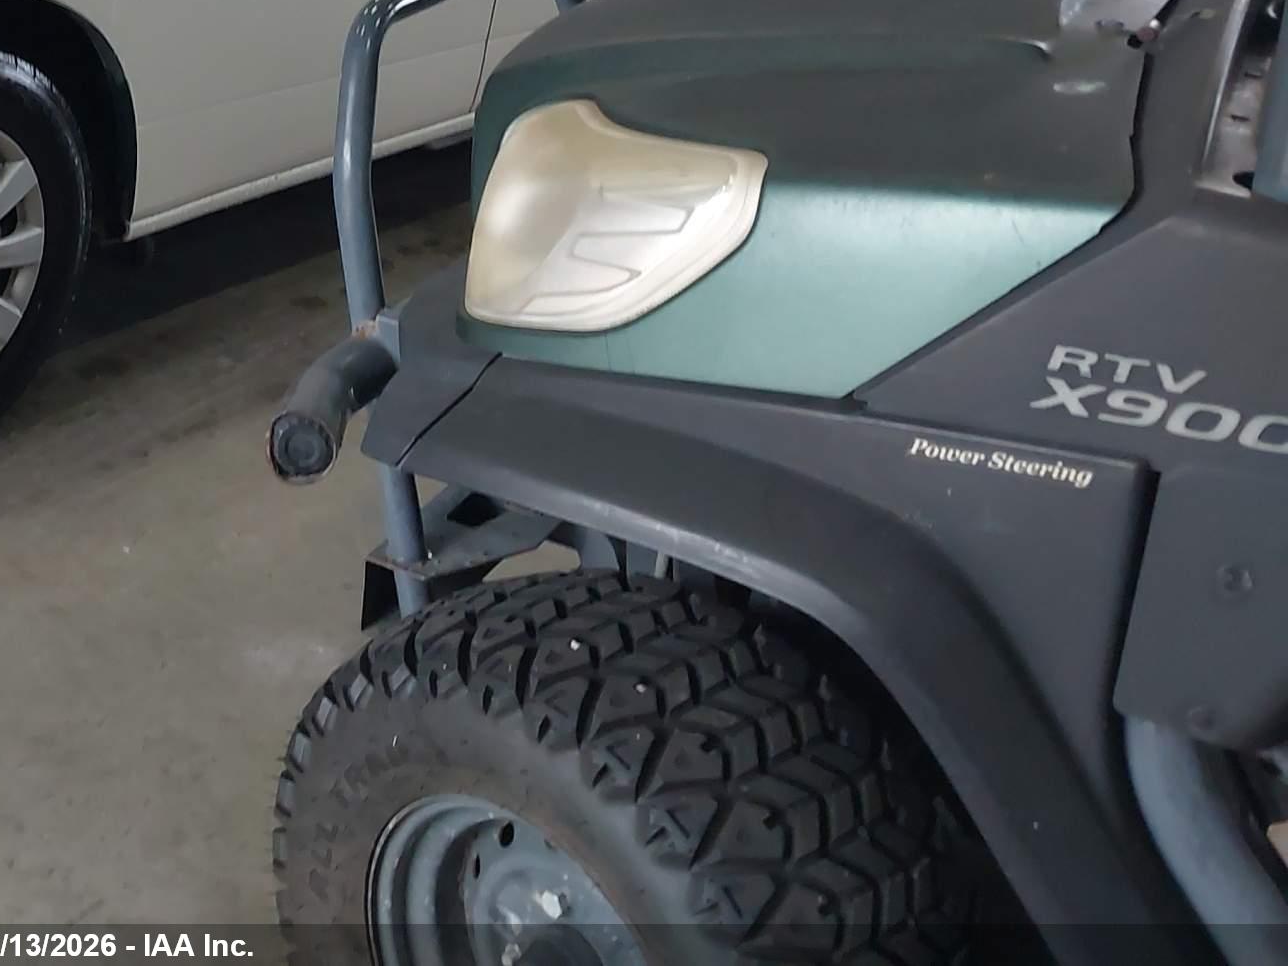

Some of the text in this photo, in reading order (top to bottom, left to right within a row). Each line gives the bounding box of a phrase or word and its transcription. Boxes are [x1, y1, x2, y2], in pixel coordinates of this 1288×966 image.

[1047, 344, 1207, 394] RTV
[910, 437, 1095, 489] Power Steering
